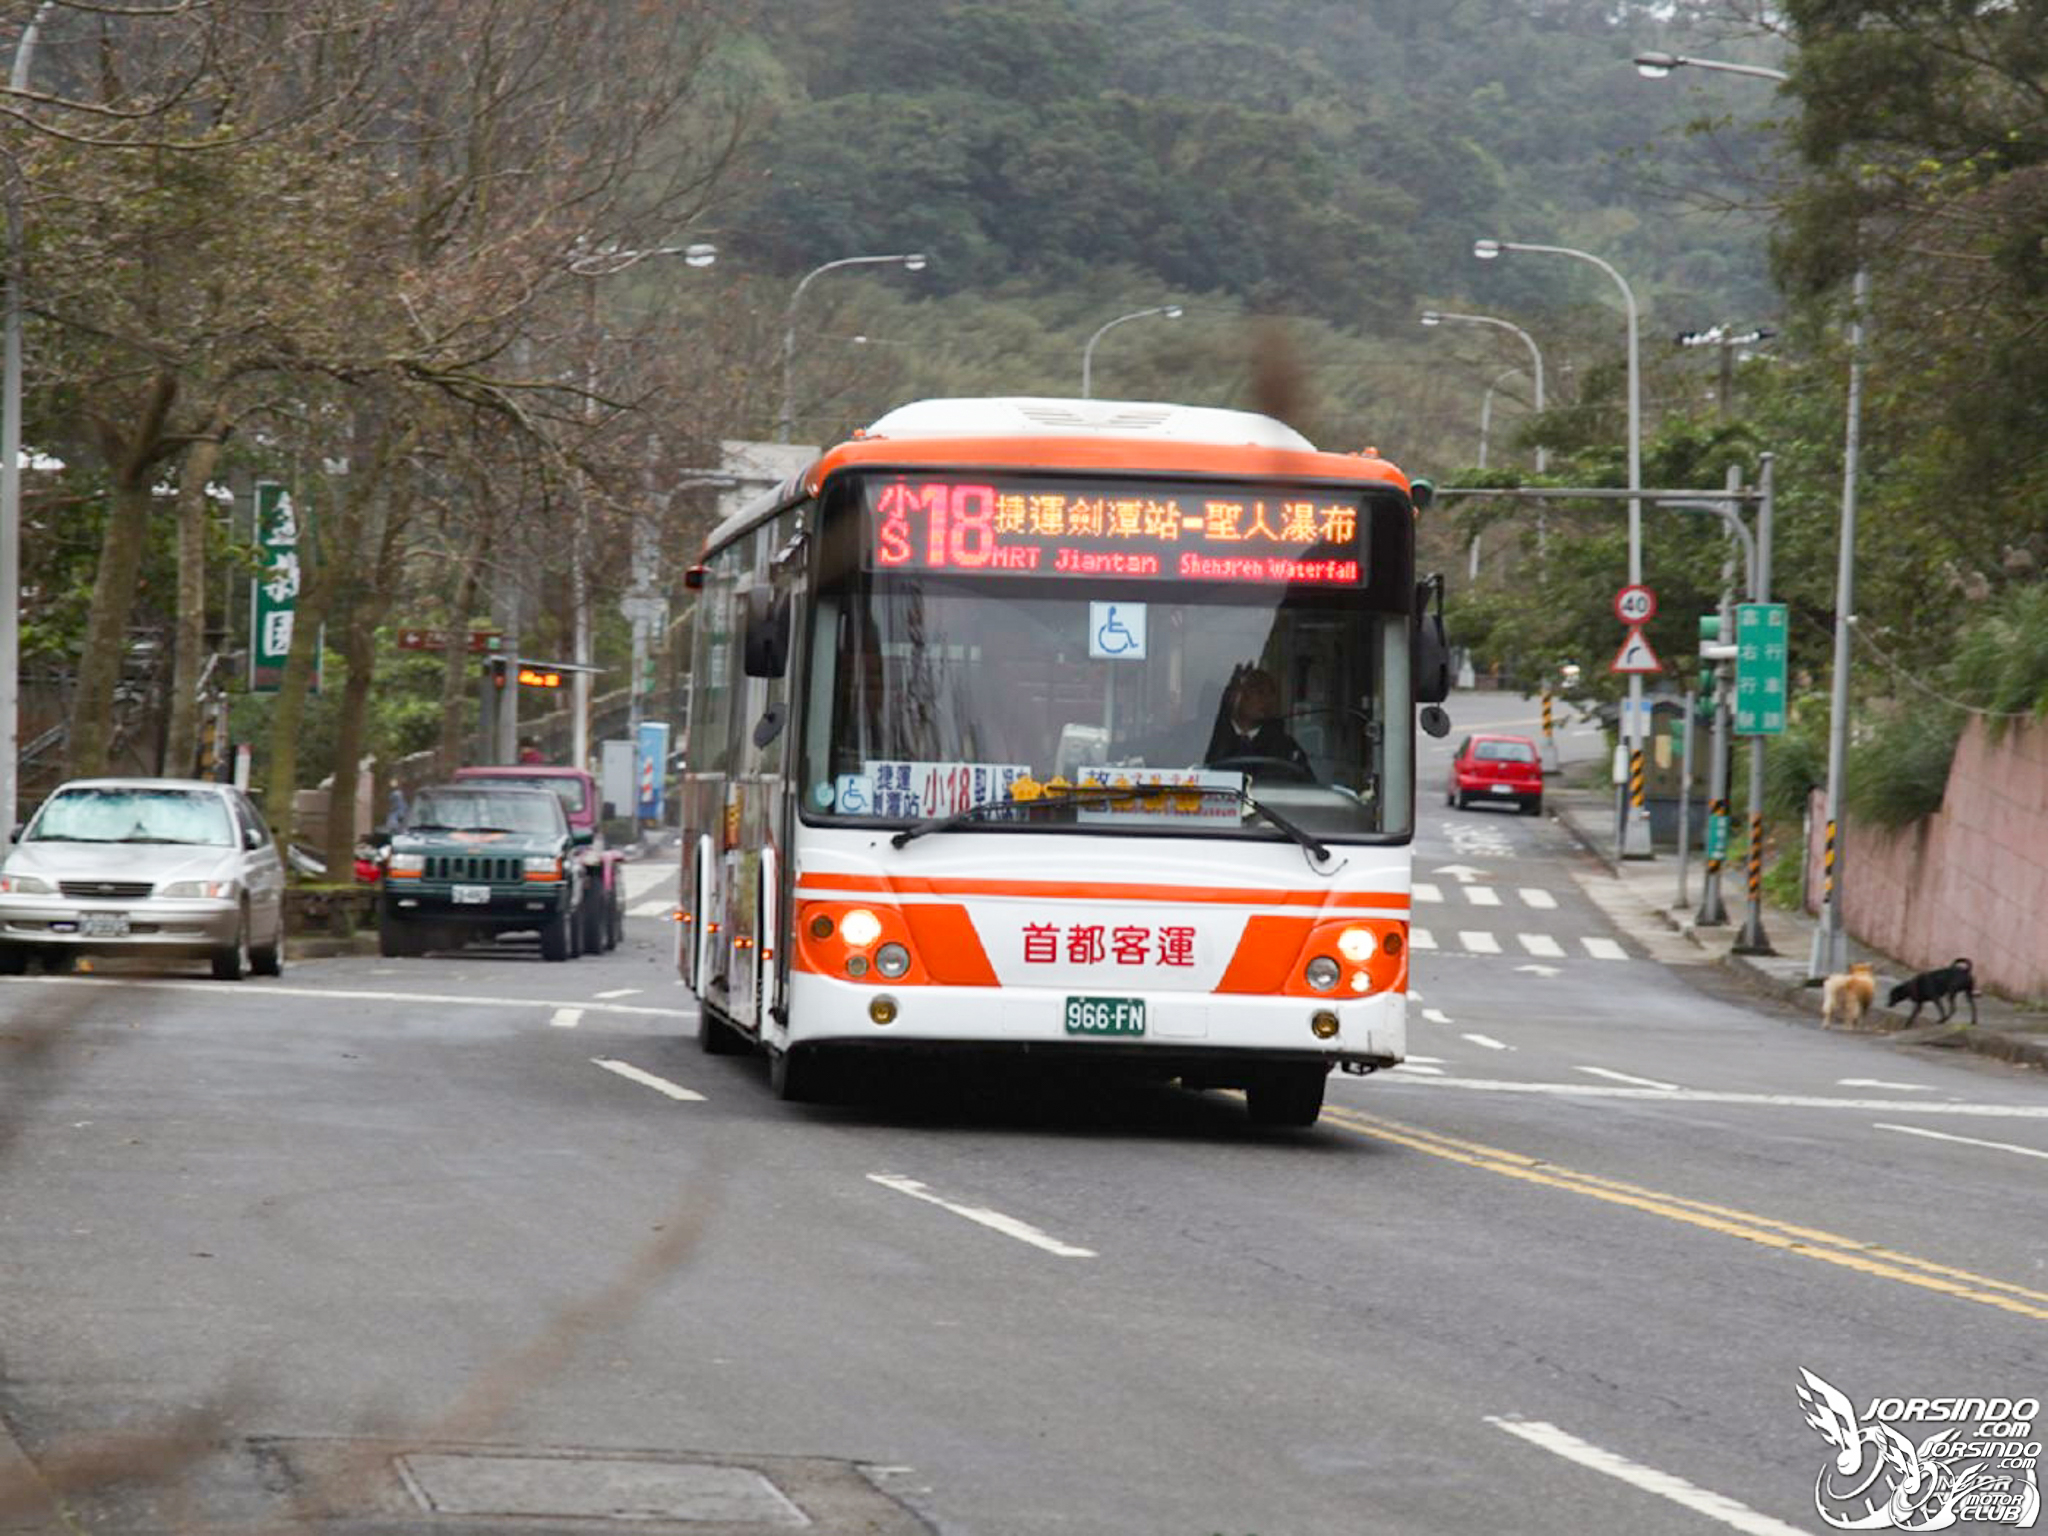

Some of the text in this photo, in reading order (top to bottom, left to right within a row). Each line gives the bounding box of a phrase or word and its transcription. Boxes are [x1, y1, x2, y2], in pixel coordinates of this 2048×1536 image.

[919, 484, 996, 567] 18
[992, 545, 1041, 569] MRT
[1054, 548, 1159, 574] Jiantan
[1267, 557, 1359, 584] Waterfall
[1623, 596, 1649, 613] 40
[1022, 922, 1196, 967] 首都客運
[1067, 1002, 1144, 1031] 966-FN
